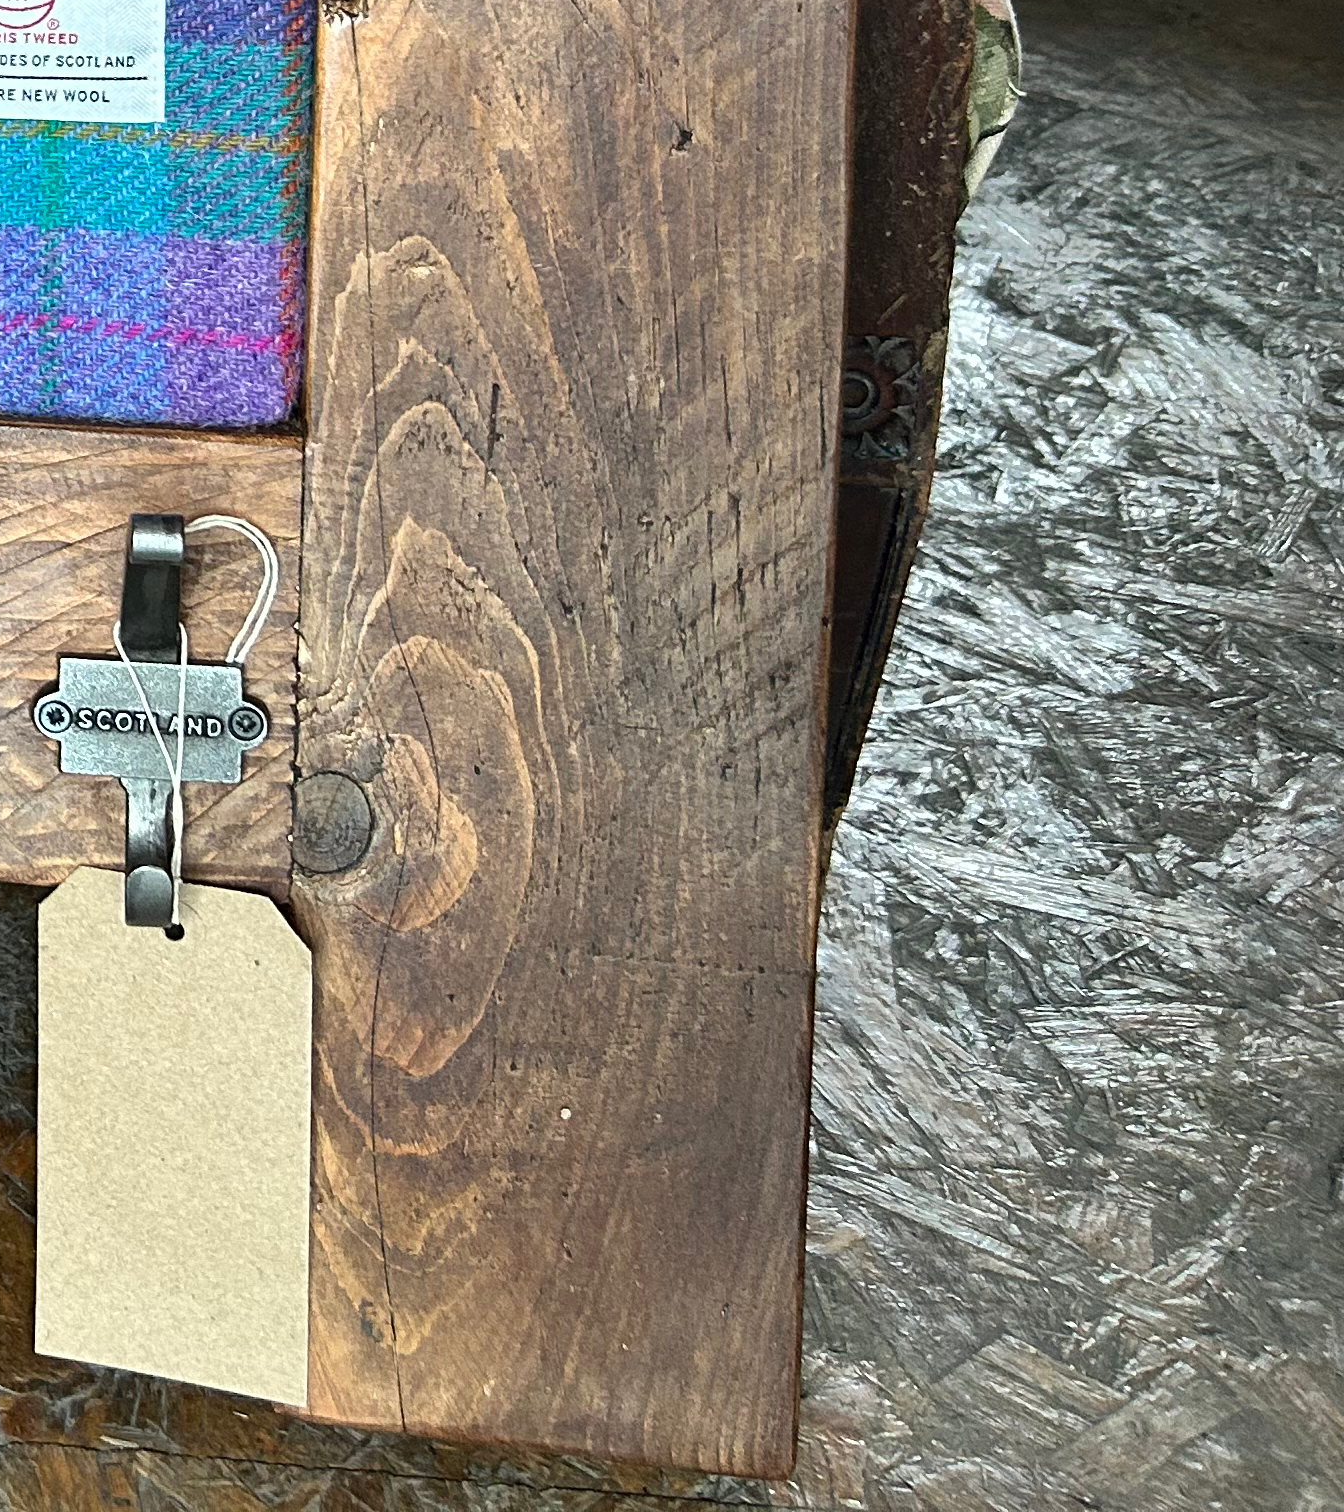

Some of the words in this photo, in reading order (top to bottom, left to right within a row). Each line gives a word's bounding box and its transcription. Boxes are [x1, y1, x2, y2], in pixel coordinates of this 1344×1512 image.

[23, 32, 79, 45] TWEED
[31, 54, 51, 67] OF
[55, 55, 136, 68] SCOTLAND
[21, 89, 58, 102] NEW
[62, 90, 111, 103] WOOL
[77, 707, 224, 737] SCOTAND
